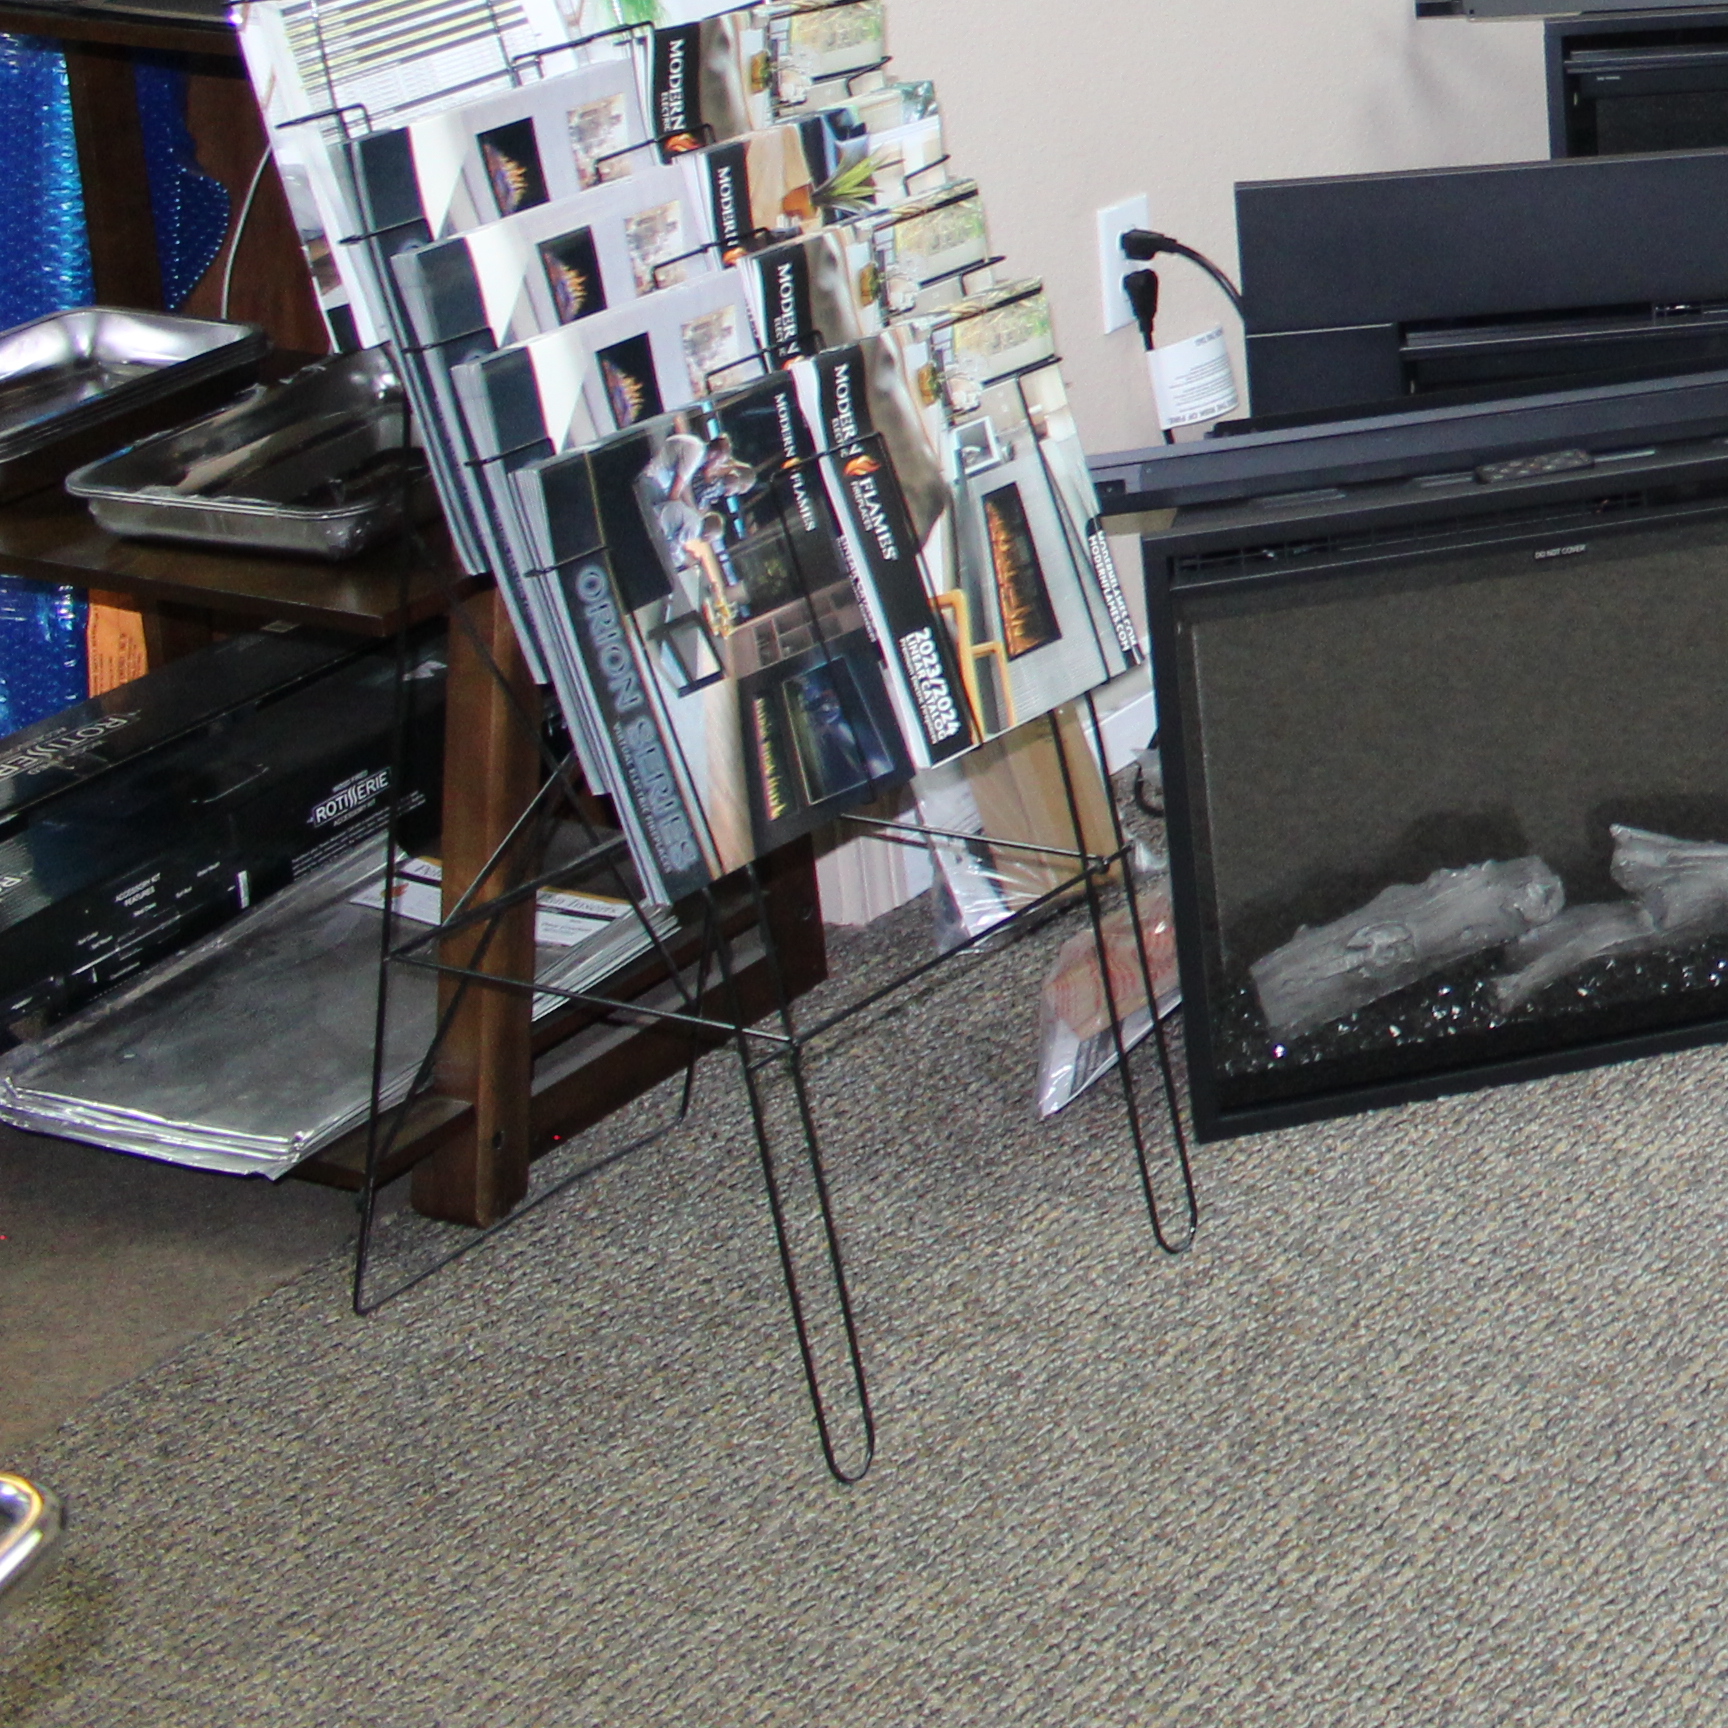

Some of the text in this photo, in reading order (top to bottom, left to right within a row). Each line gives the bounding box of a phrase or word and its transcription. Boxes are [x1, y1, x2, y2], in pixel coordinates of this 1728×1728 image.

[668, 38, 687, 132] MODERN
[774, 392, 816, 532] MODERN FLAMES
[858, 475, 899, 561] FLAMES
[575, 563, 701, 873] ORION SERIES
[904, 633, 949, 742] LINEAR CATALOG
[914, 625, 962, 738] 2023/2024
[314, 770, 390, 823] ROTISSERIE
[612, 722, 673, 874] VIRTUAL ELECTRIC FIREPLACES
